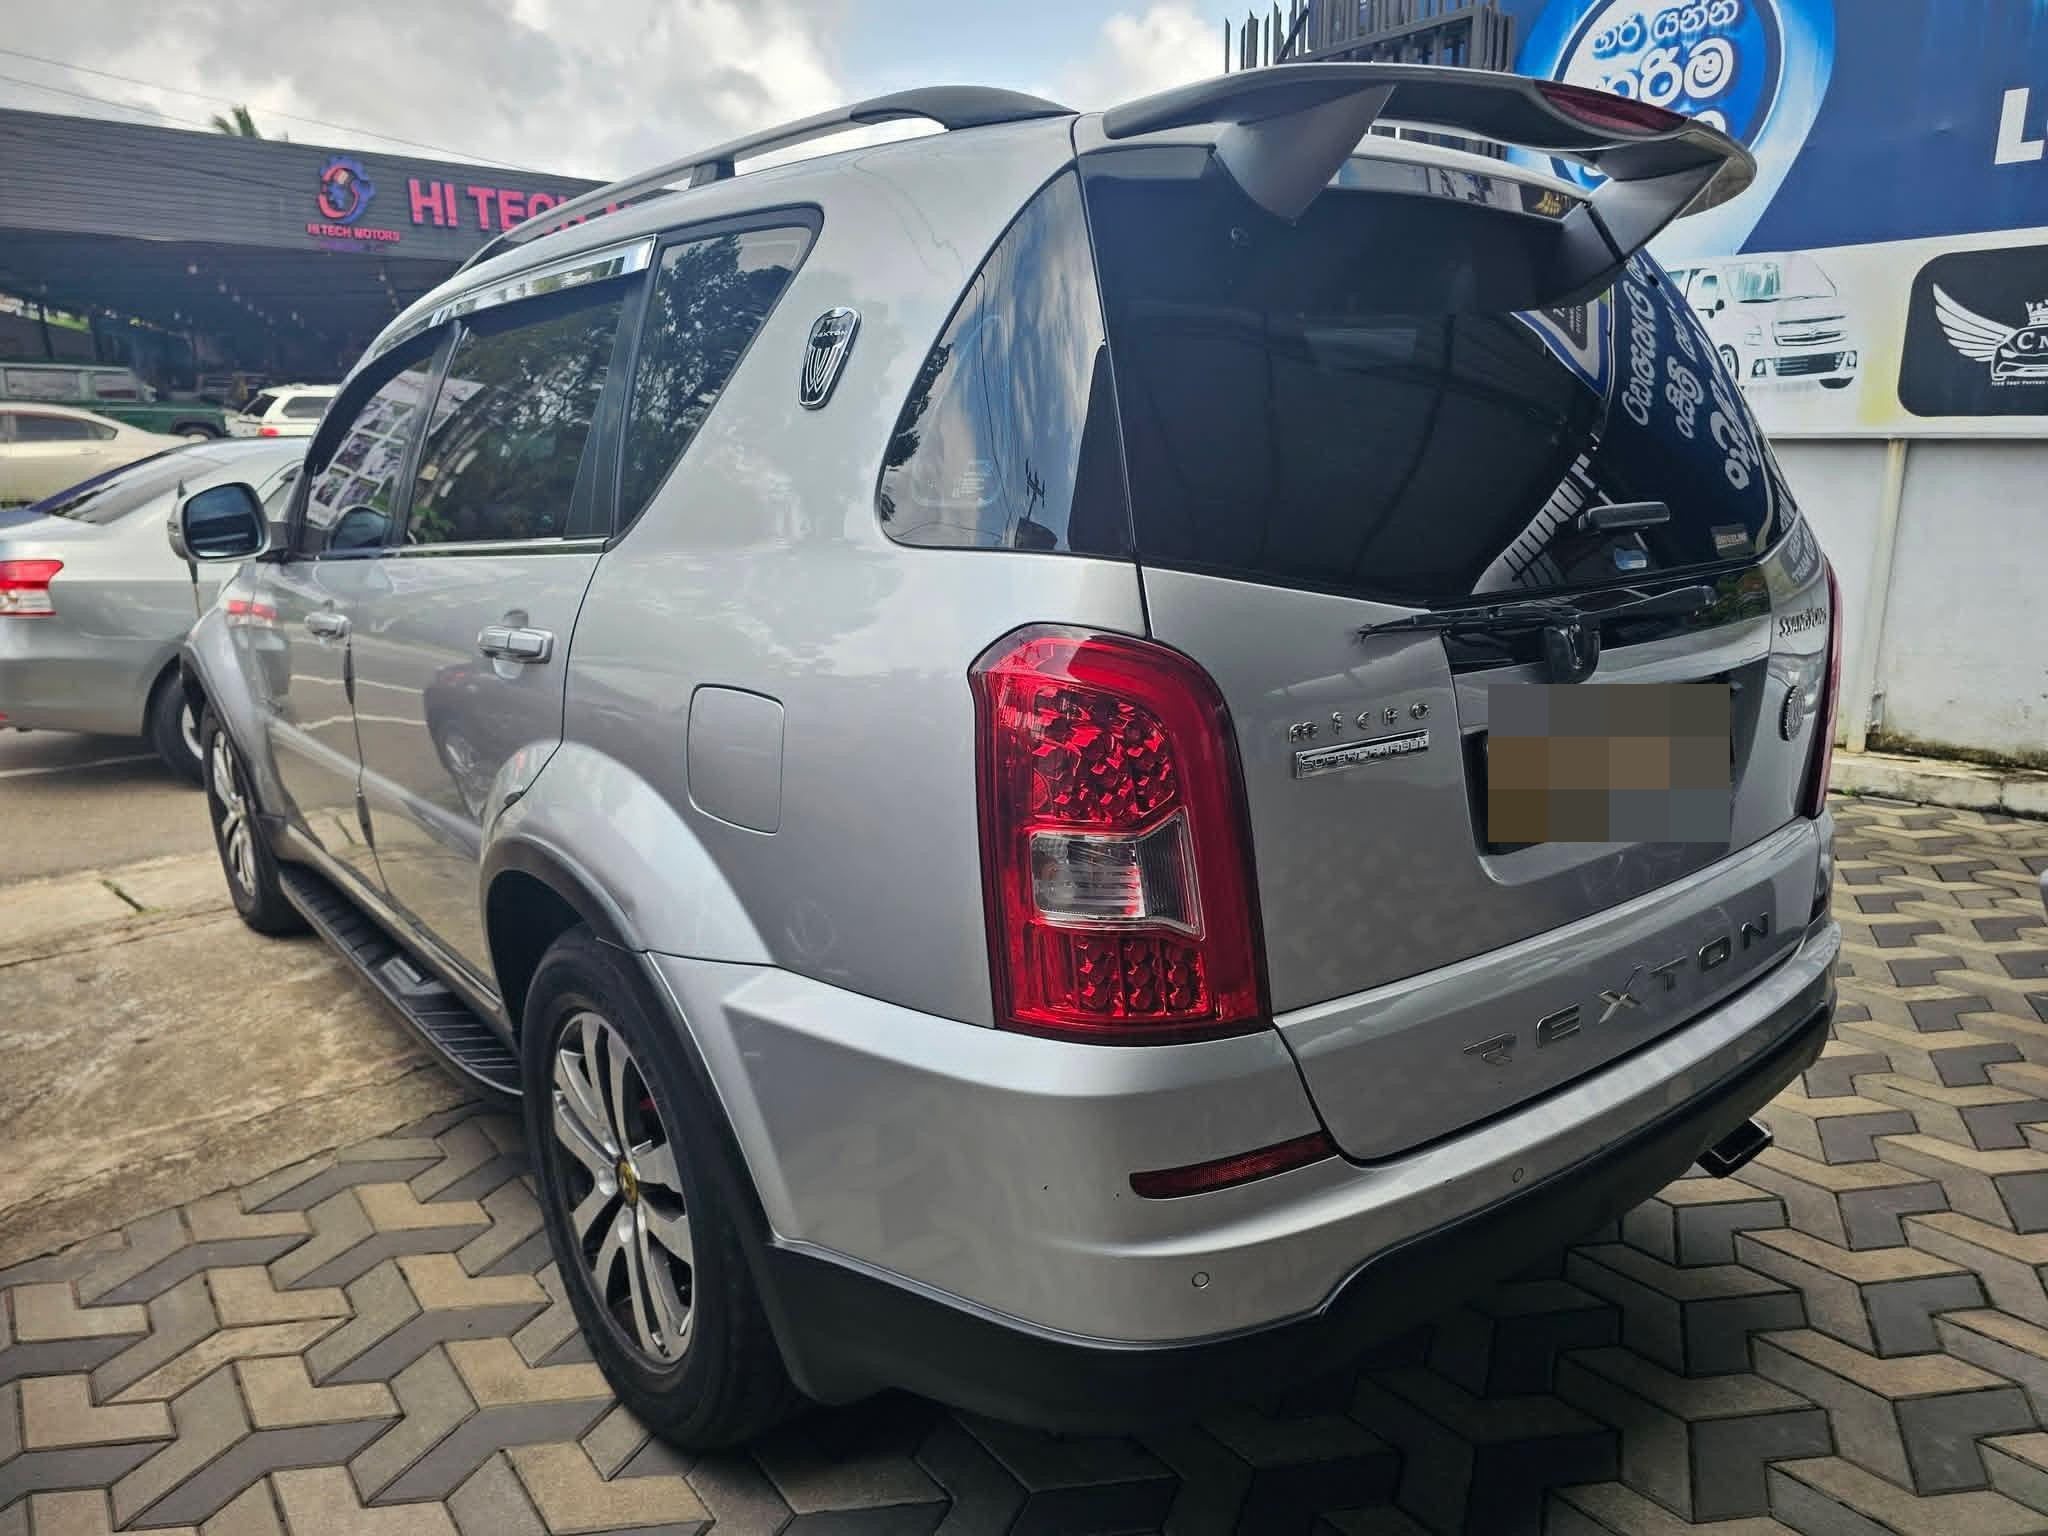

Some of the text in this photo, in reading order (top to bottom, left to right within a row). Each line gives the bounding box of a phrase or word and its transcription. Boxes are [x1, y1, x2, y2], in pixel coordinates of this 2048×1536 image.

[408, 178, 458, 227] HI
[321, 225, 352, 239] TECH
[354, 228, 400, 242] MOTORS
[1463, 911, 1769, 1066] REXTON
